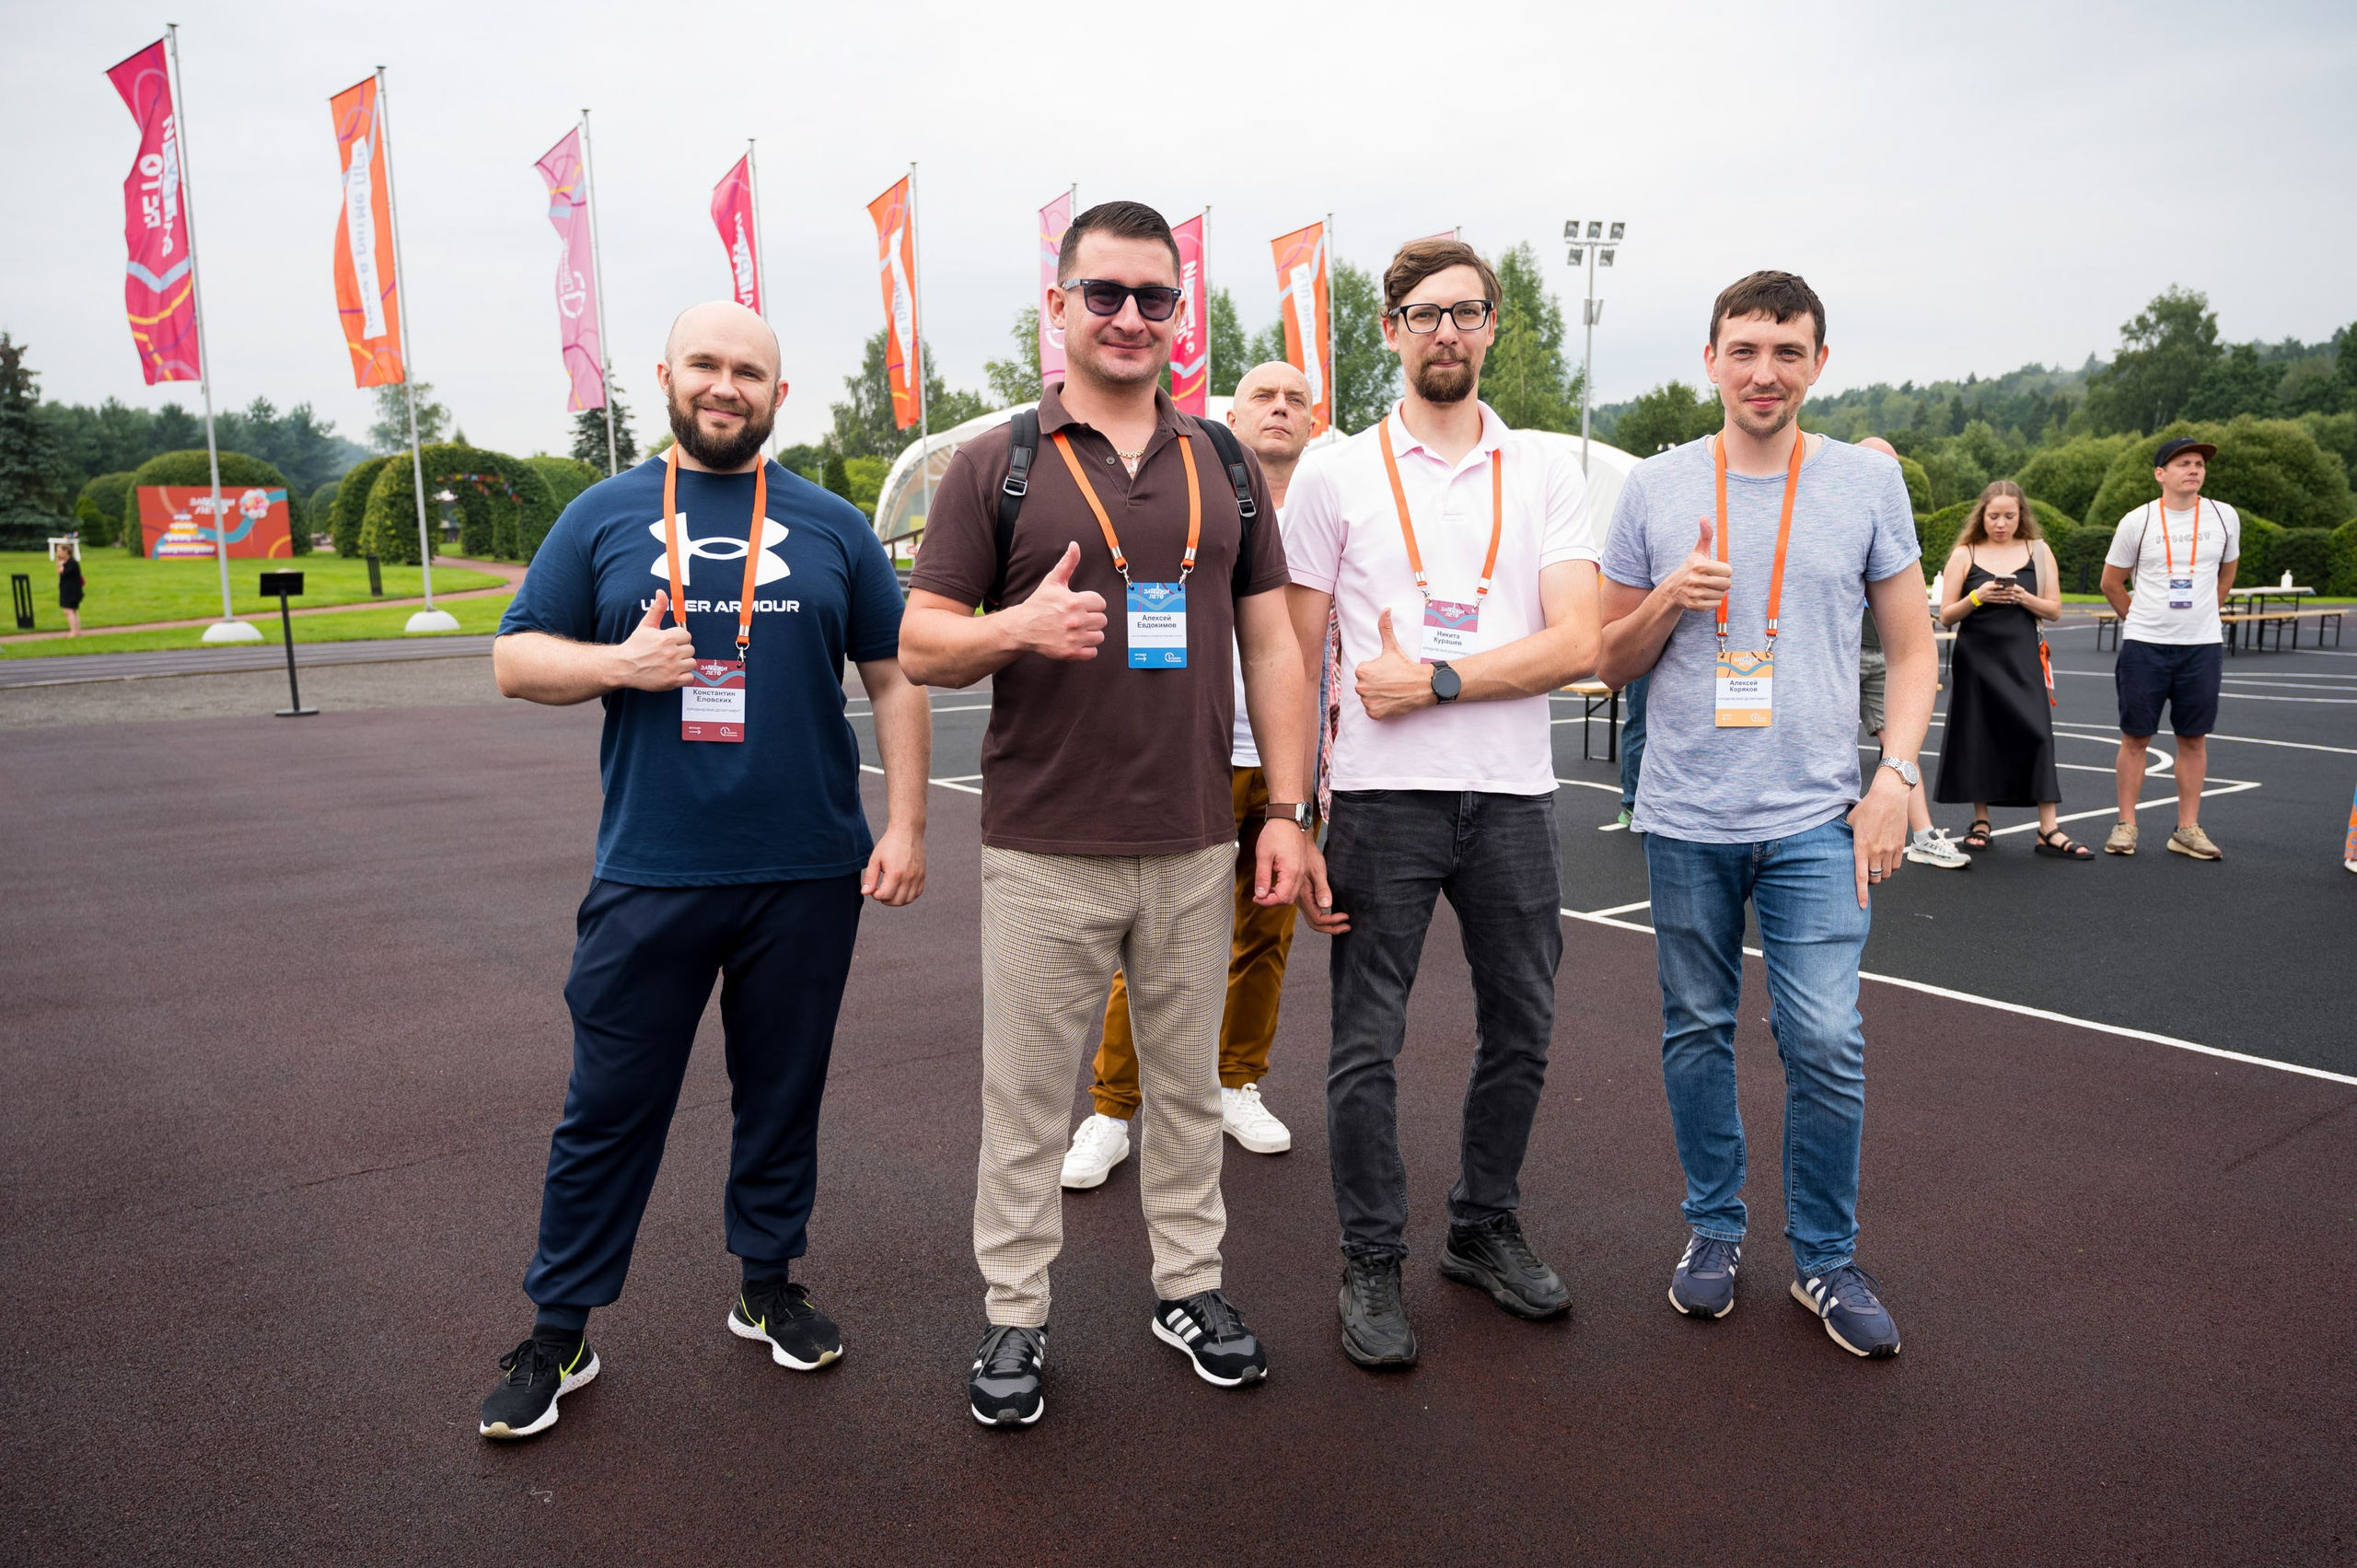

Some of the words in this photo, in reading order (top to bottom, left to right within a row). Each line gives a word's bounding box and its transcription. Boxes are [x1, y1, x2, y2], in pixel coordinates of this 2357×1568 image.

[641, 599, 711, 612] UER
[1436, 630, 1460, 639] Никита
[1434, 636, 1462, 646] Курашев
